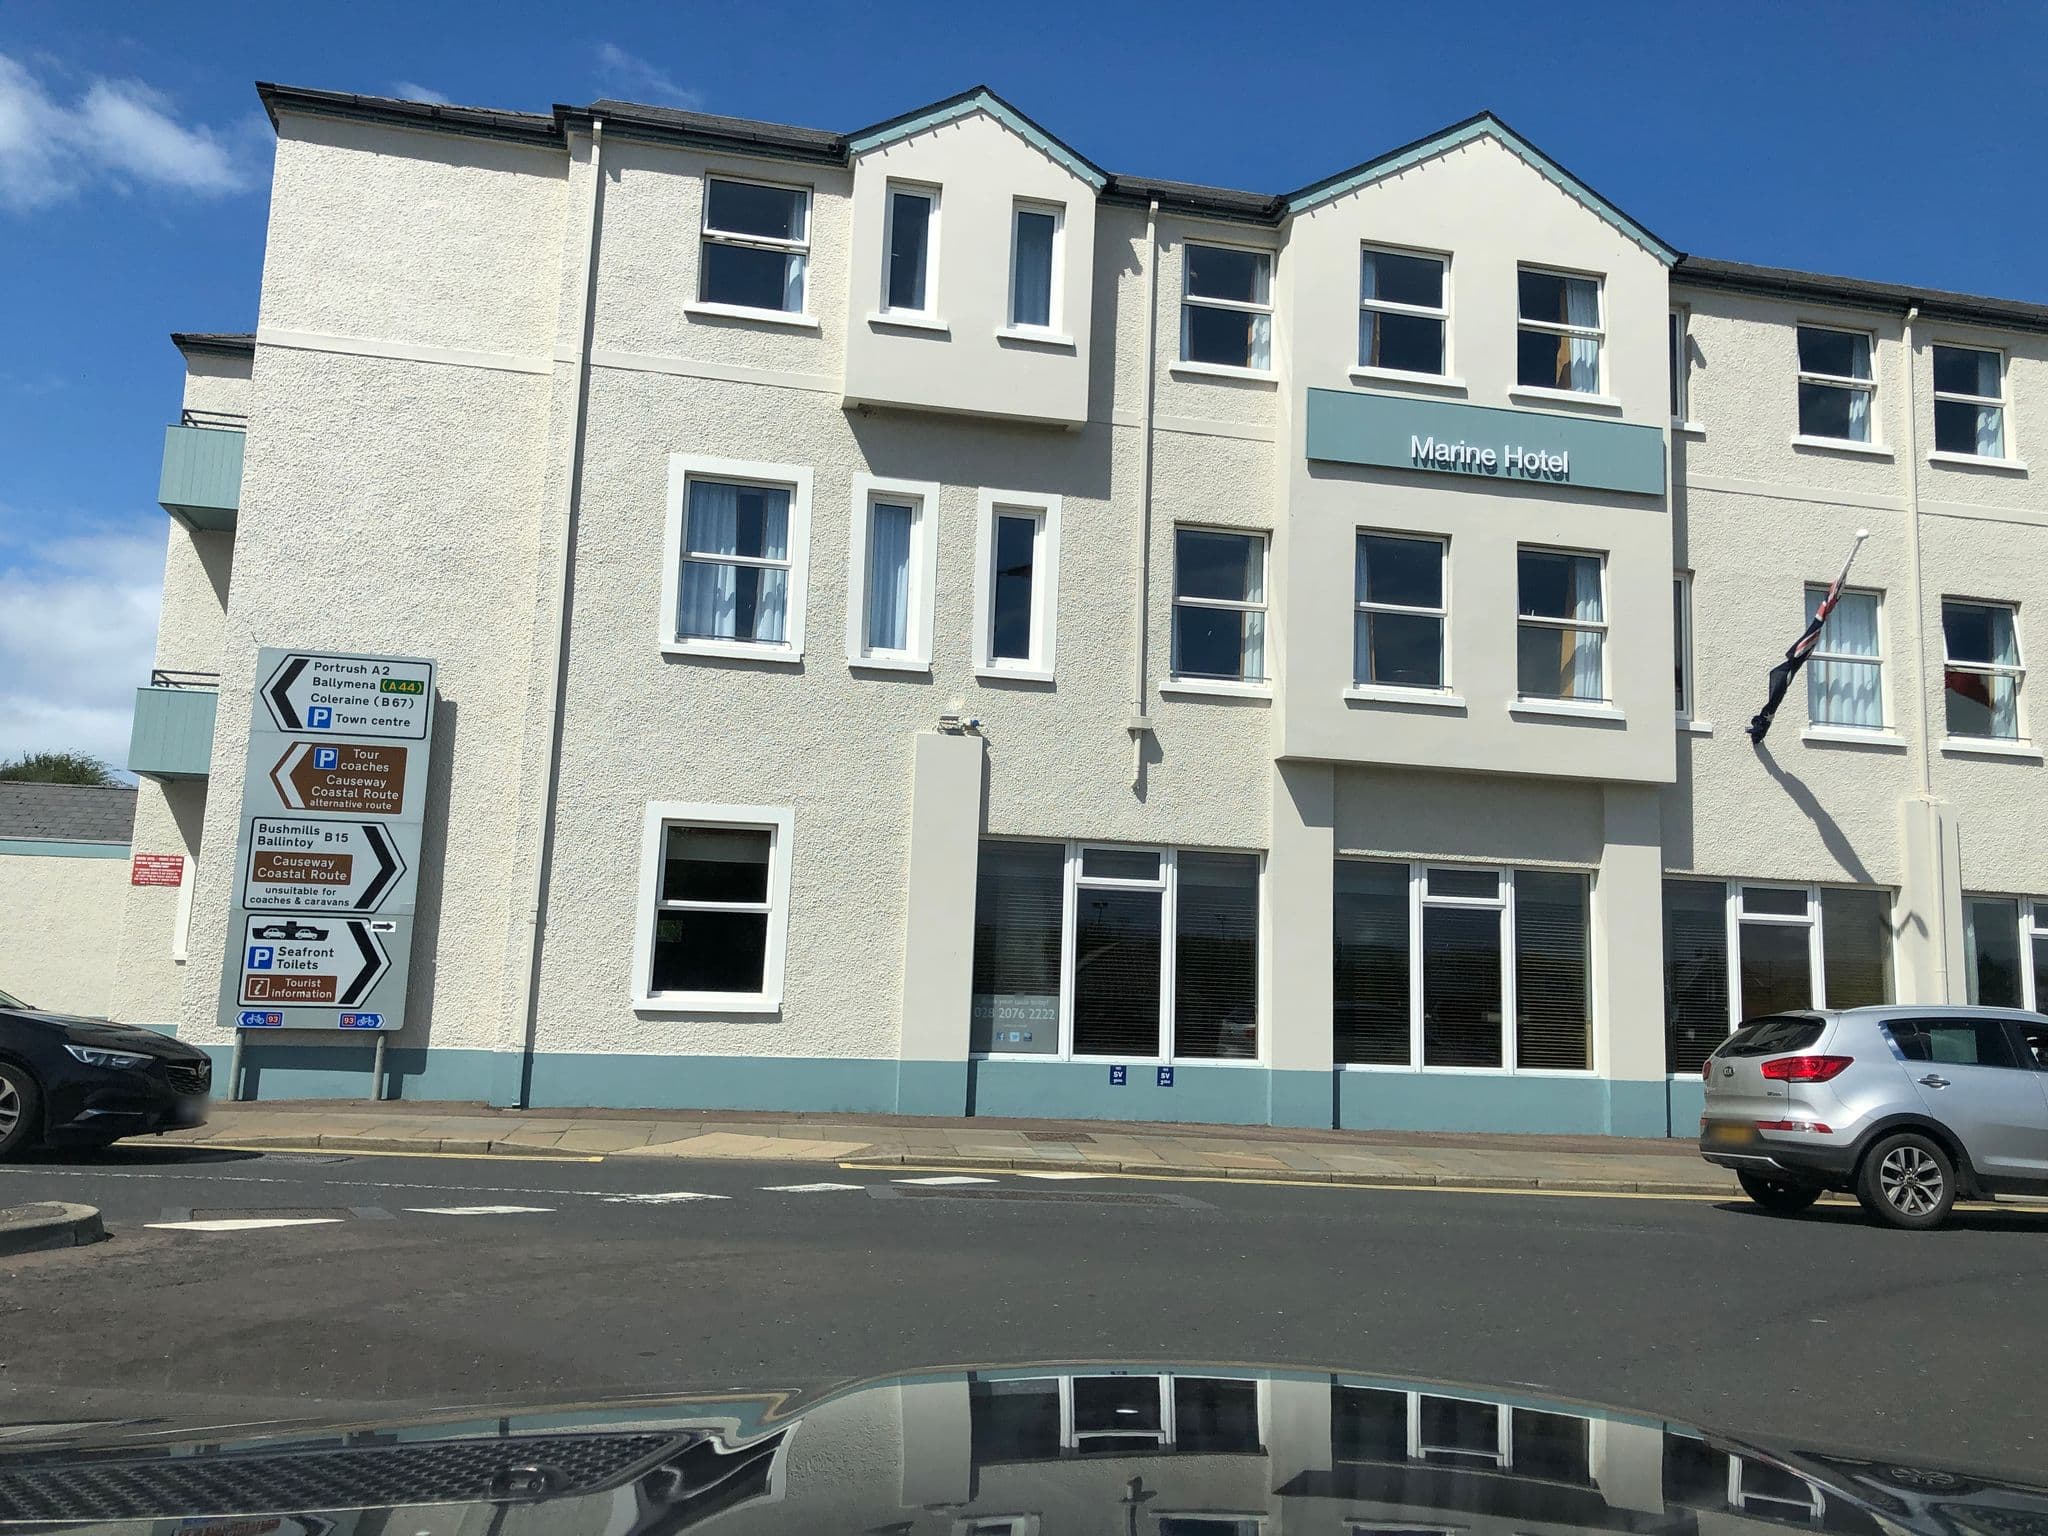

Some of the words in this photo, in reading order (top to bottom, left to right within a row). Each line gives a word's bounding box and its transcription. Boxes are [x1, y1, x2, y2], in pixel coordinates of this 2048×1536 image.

[1411, 434, 1497, 467] Marine
[1504, 445, 1569, 474] Hotel
[314, 662, 367, 674] Portrush
[372, 666, 390, 675] A2
[313, 677, 376, 690] Ballymena
[381, 679, 423, 693] (A44)
[311, 693, 370, 705] Coleraine
[313, 709, 329, 725] P
[336, 714, 367, 724] Town
[371, 717, 410, 727] centre
[319, 750, 335, 767] P
[353, 749, 380, 759] Tour
[340, 761, 389, 772] coaches
[326, 774, 386, 788] Causeway
[311, 786, 358, 798] Coastal
[363, 789, 399, 800] Route
[309, 798, 362, 809] alternative
[366, 801, 393, 810] route
[259, 824, 320, 835] Bushmills
[257, 836, 314, 848] Ballintoy
[273, 855, 335, 868] Causeway
[257, 868, 306, 879] Coastal
[311, 870, 348, 880] Route
[265, 886, 318, 896] unsuitable
[322, 888, 336, 896] for
[250, 896, 291, 905] coaches
[294, 897, 300, 905] &
[304, 898, 349, 906] caravans
[254, 949, 270, 967] P
[278, 947, 334, 957] Seafront
[276, 959, 318, 970] Toilets
[285, 978, 321, 987] Tourist
[271, 985, 332, 998] information
[999, 1007, 1025, 1019] 2076
[1029, 1008, 1056, 1020] 2222
[344, 1016, 354, 1024] 93
